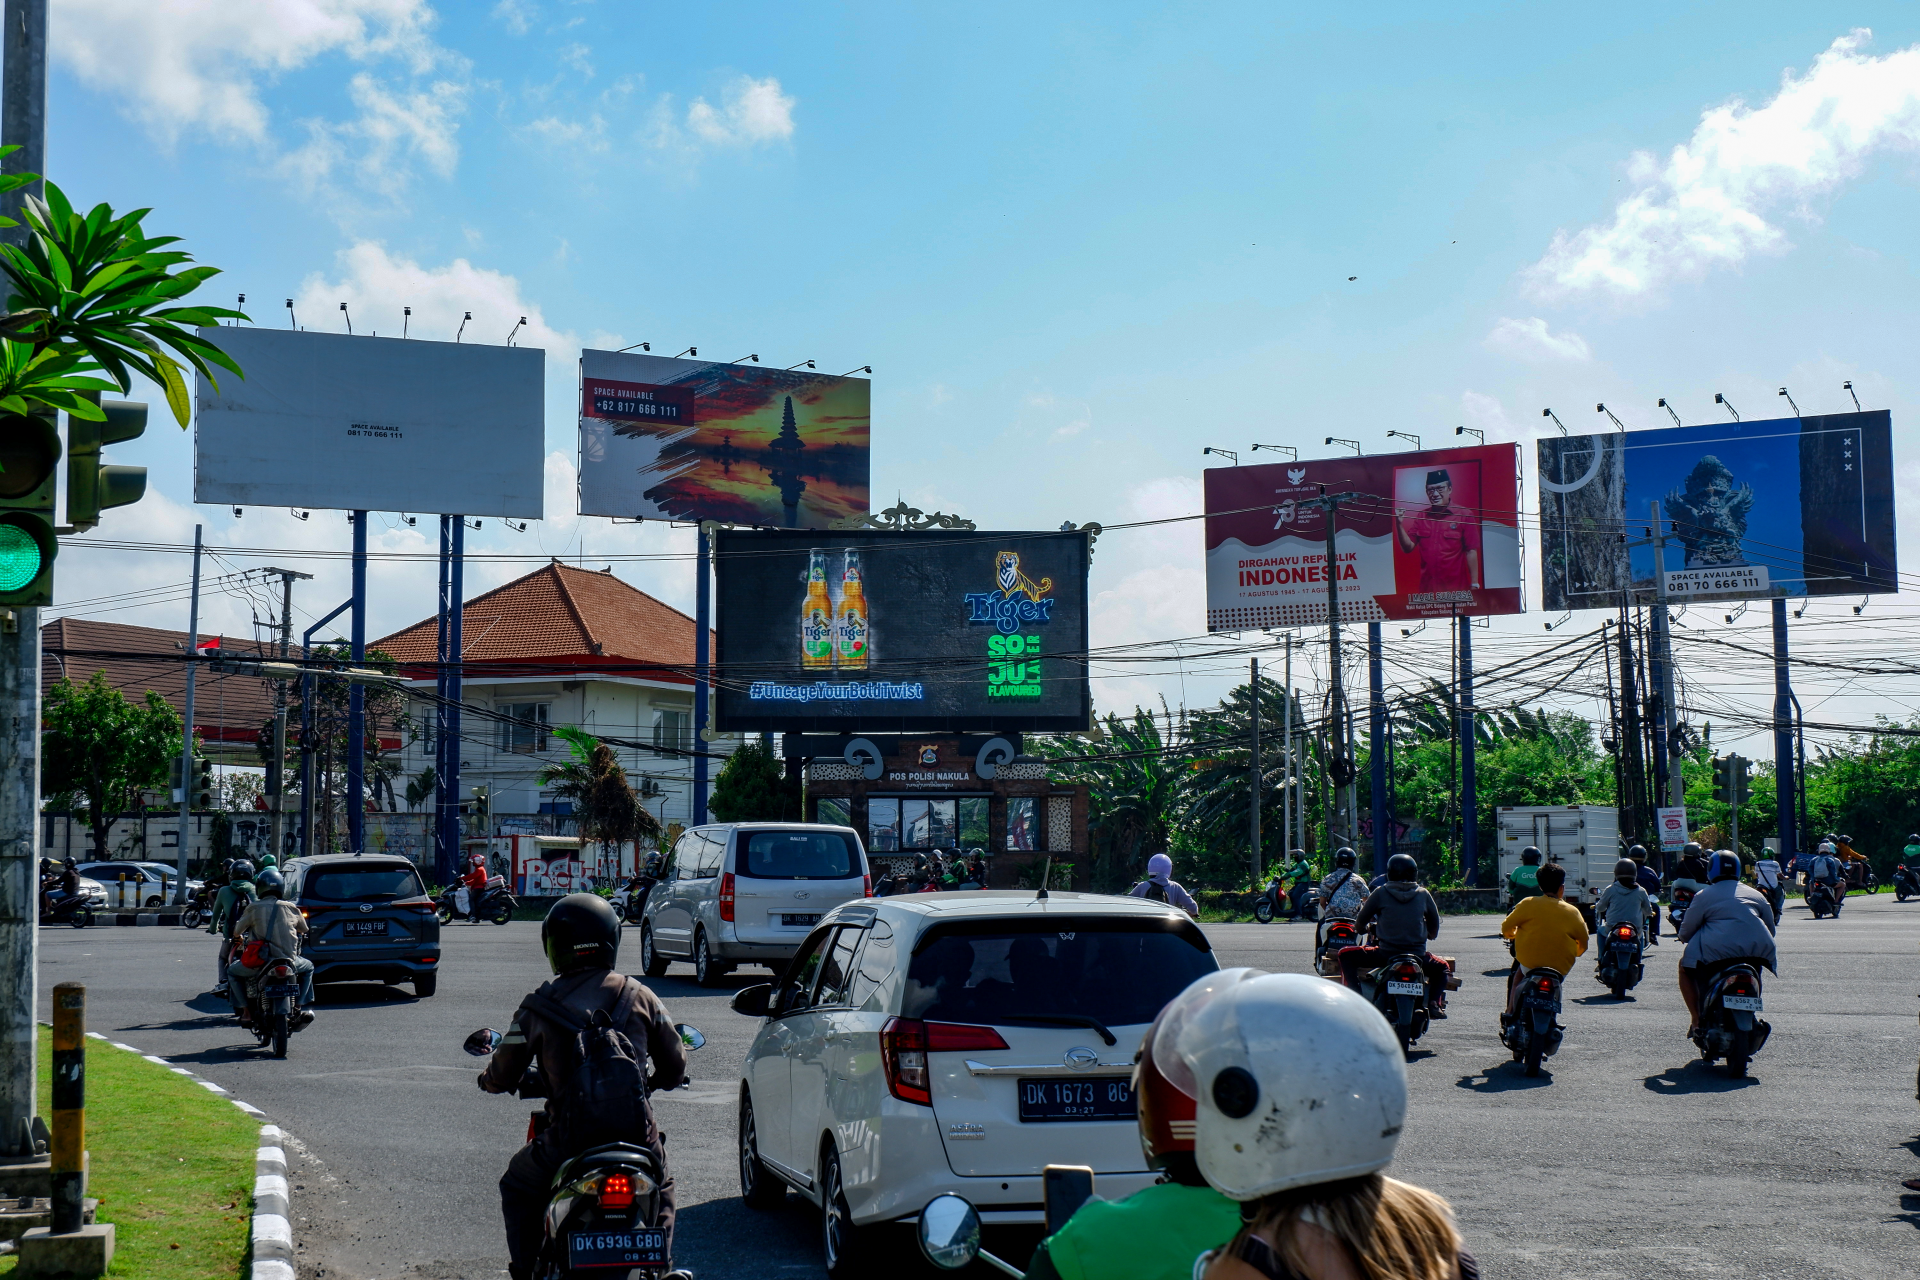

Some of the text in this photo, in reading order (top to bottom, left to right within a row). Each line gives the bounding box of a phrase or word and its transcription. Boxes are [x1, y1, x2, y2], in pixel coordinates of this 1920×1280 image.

[593, 387, 653, 400] SPACE AVAILABLE
[597, 400, 676, 417] +62 817 666 111
[1239, 557, 1299, 568] DIRGAHAYU
[1239, 564, 1358, 587] INDONESIA
[1671, 569, 1753, 581] SPACE AVAILABLE
[1668, 577, 1759, 592] 081 70 666 111
[965, 590, 1054, 634] Tiger
[804, 626, 831, 640] Tiger
[839, 626, 866, 640] Tiger
[988, 635, 1024, 659] SO
[750, 682, 922, 702] #UncageYourBoldTwist
[988, 685, 1041, 696] FLAVOURED
[346, 923, 355, 931] DK
[357, 922, 372, 931] 1449
[1026, 1084, 1048, 1105] DK
[1053, 1083, 1094, 1104] 1673
[950, 1123, 984, 1133] ASTRA
[576, 1237, 594, 1251] DK
[597, 1234, 632, 1249] 6936
